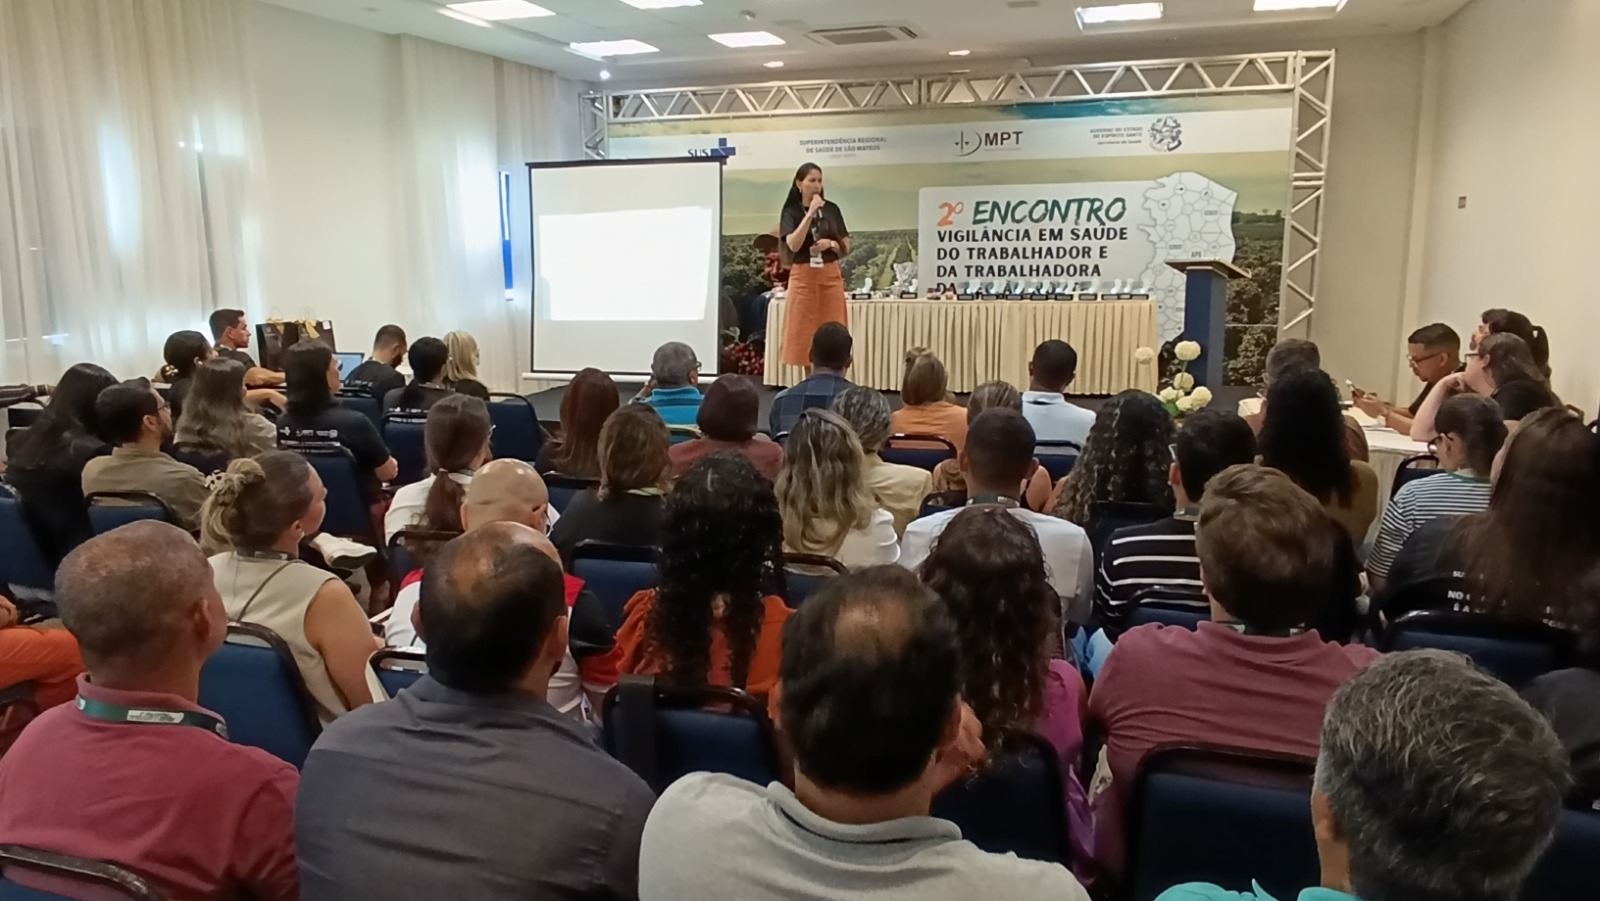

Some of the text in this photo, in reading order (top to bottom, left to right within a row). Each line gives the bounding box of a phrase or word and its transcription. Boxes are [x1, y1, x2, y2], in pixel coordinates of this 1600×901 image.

[799, 136, 857, 146] SUPERINTENDÊNCIA
[984, 131, 1024, 146] MPT
[815, 145, 834, 153] SAÚDE
[844, 144, 856, 152] SÃO
[972, 197, 1127, 226] ENCONTRO
[937, 225, 1128, 243] VIGILÂNCIA EM SAÚDE
[936, 246, 1108, 261] DO TRABALHADOR E
[936, 264, 1102, 278] DA TRABALHADORA
[1447, 590, 1464, 600] NO
